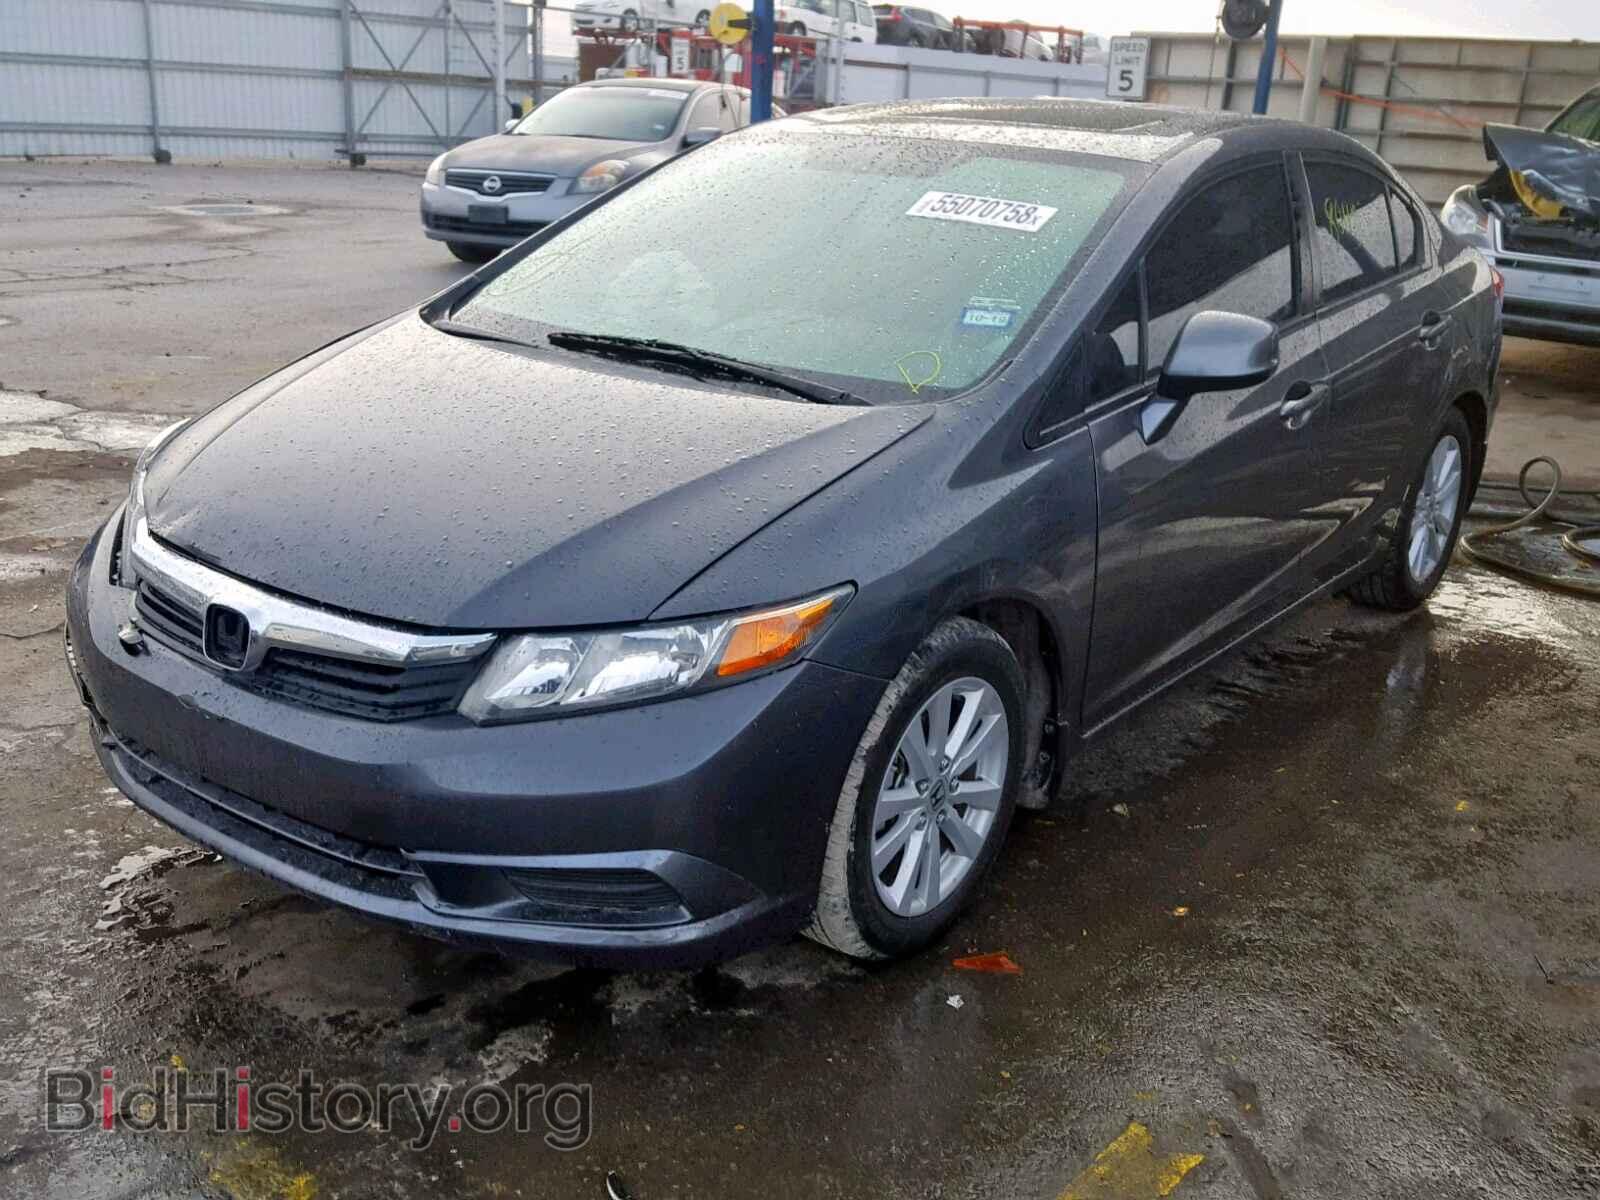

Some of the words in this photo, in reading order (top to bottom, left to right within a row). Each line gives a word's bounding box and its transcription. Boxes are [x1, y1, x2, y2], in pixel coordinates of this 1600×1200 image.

[1113, 42, 1145, 52] SPEED
[1114, 56, 1141, 66] LIMIT
[1119, 70, 1133, 92] 5
